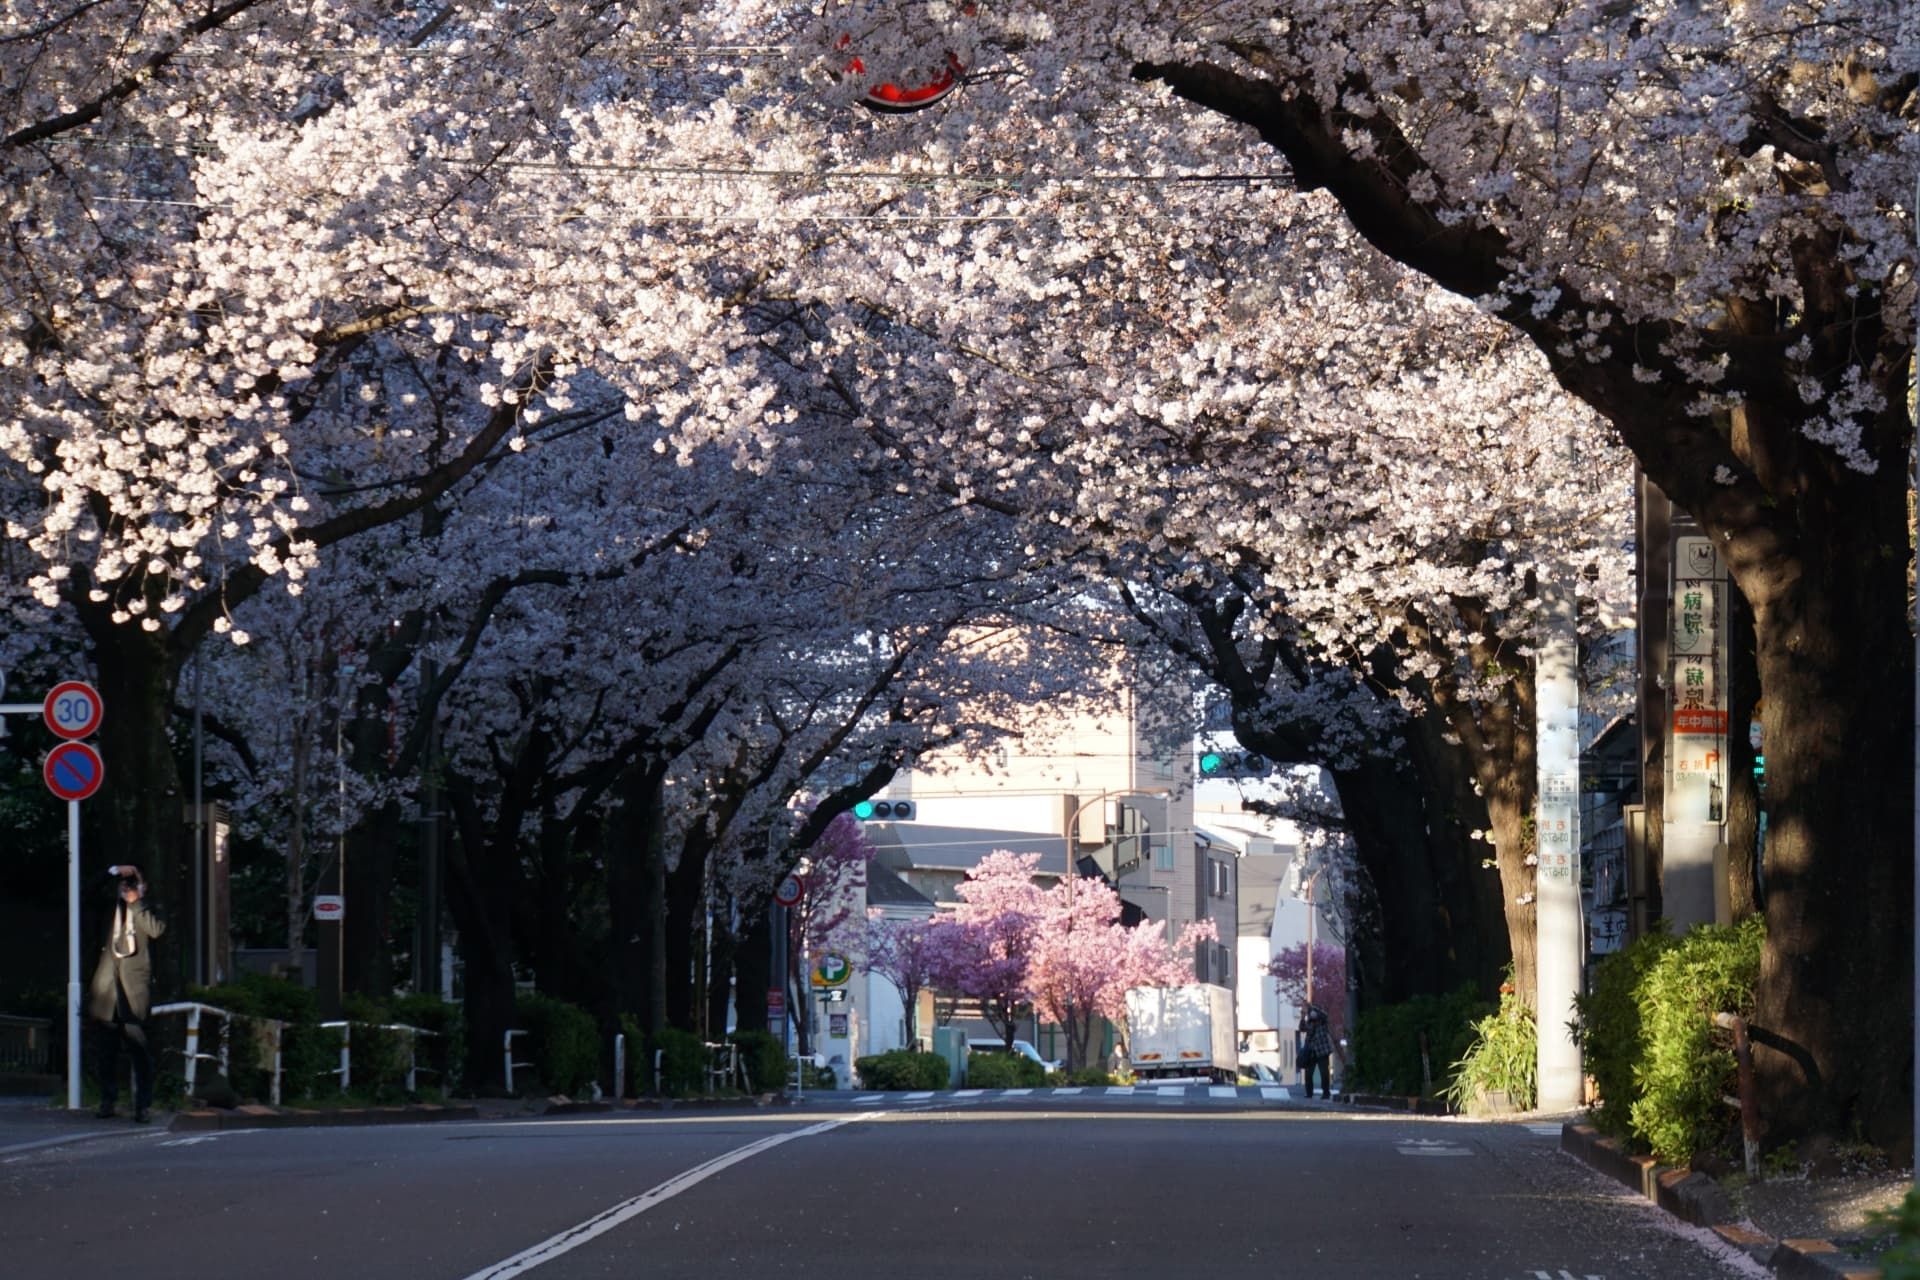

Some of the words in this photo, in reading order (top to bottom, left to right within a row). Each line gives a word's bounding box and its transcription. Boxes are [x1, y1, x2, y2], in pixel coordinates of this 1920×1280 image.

[58, 698, 89, 722] 30
[1678, 715, 1725, 729] 年中無休
[826, 957, 844, 980] P
